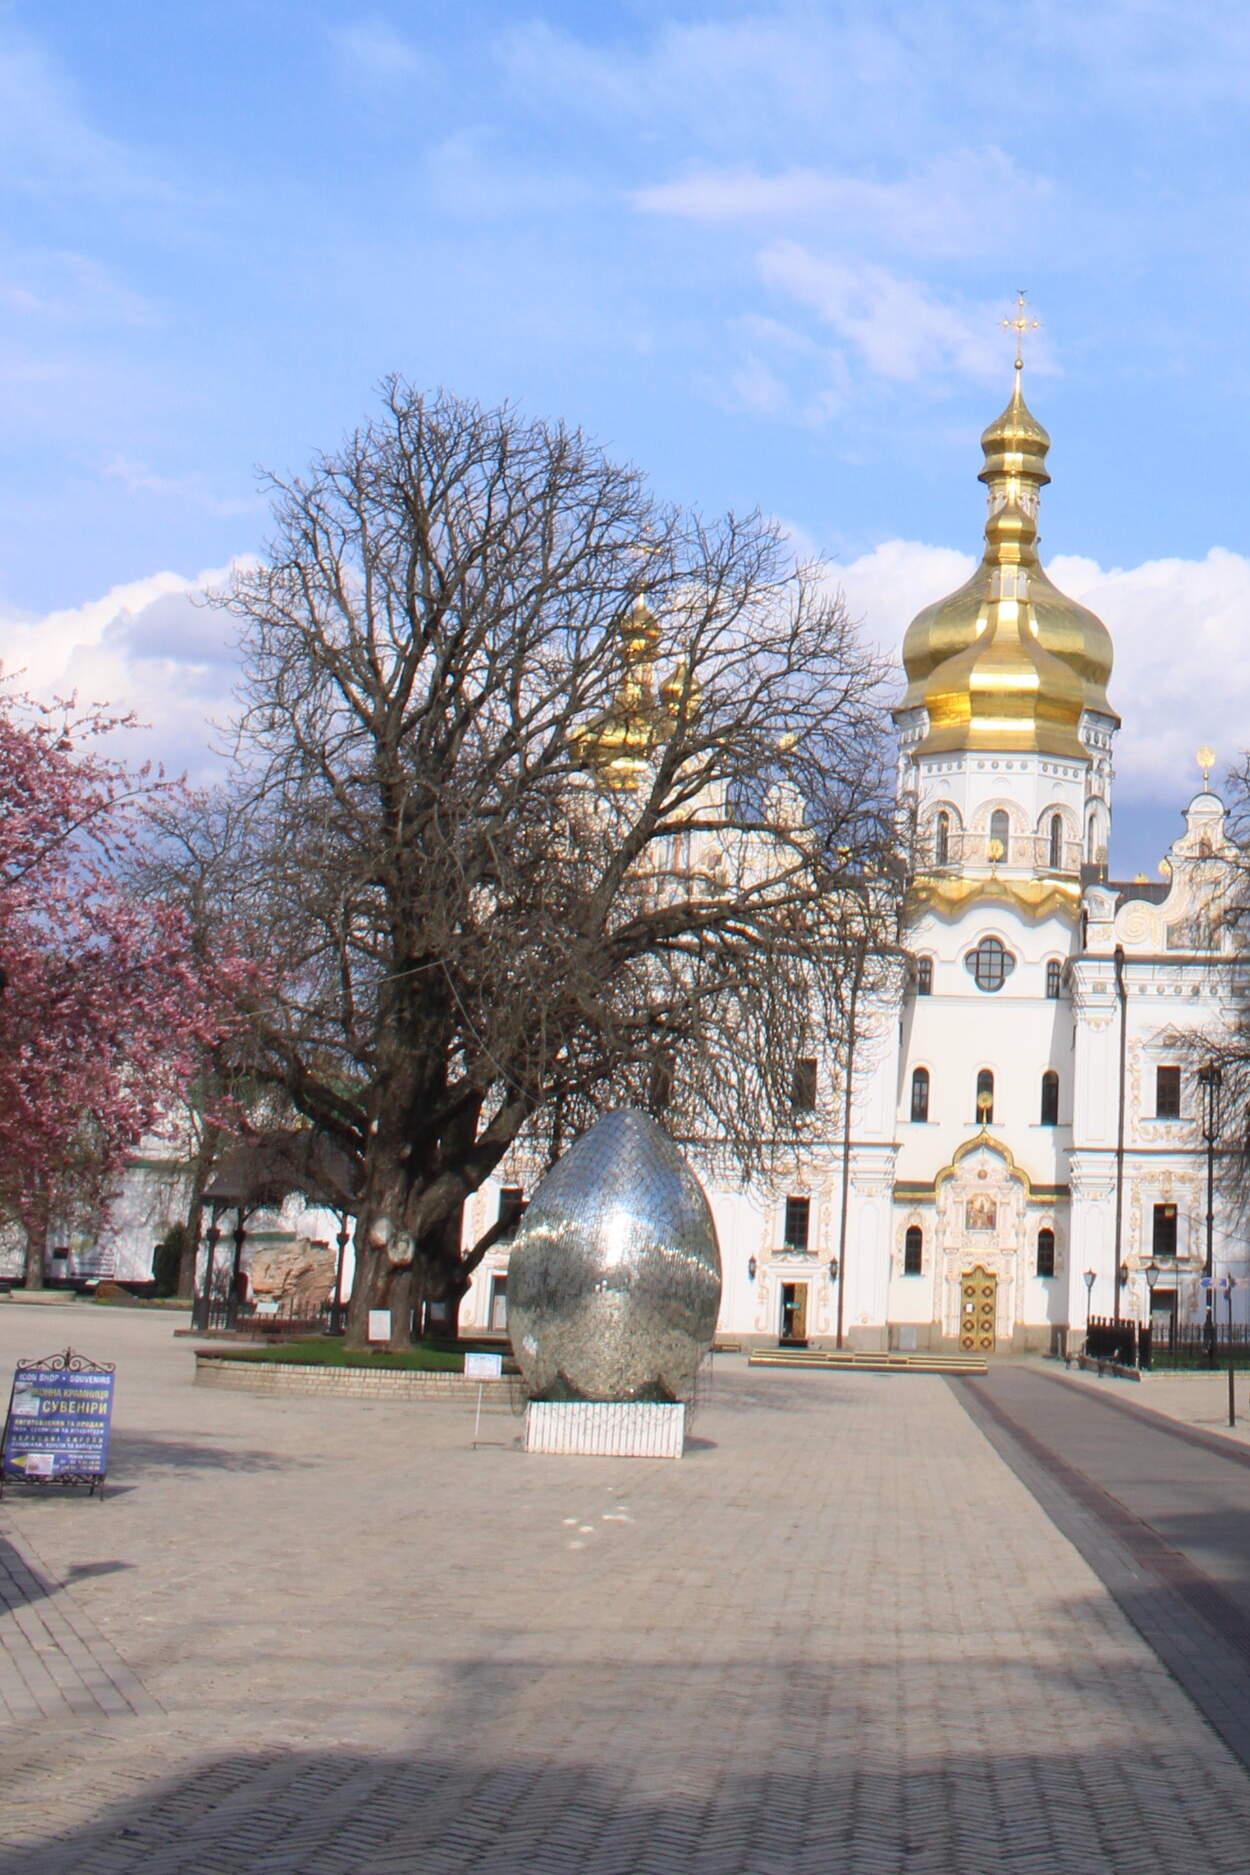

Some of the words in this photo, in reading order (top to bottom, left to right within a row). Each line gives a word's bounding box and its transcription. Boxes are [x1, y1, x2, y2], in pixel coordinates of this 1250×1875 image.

[19, 1372, 37, 1381] ICON
[39, 1373, 60, 1382] SHOP
[69, 1374, 111, 1384] SOUVENIRS
[42, 1400, 108, 1414] СУВЕНІРИ
